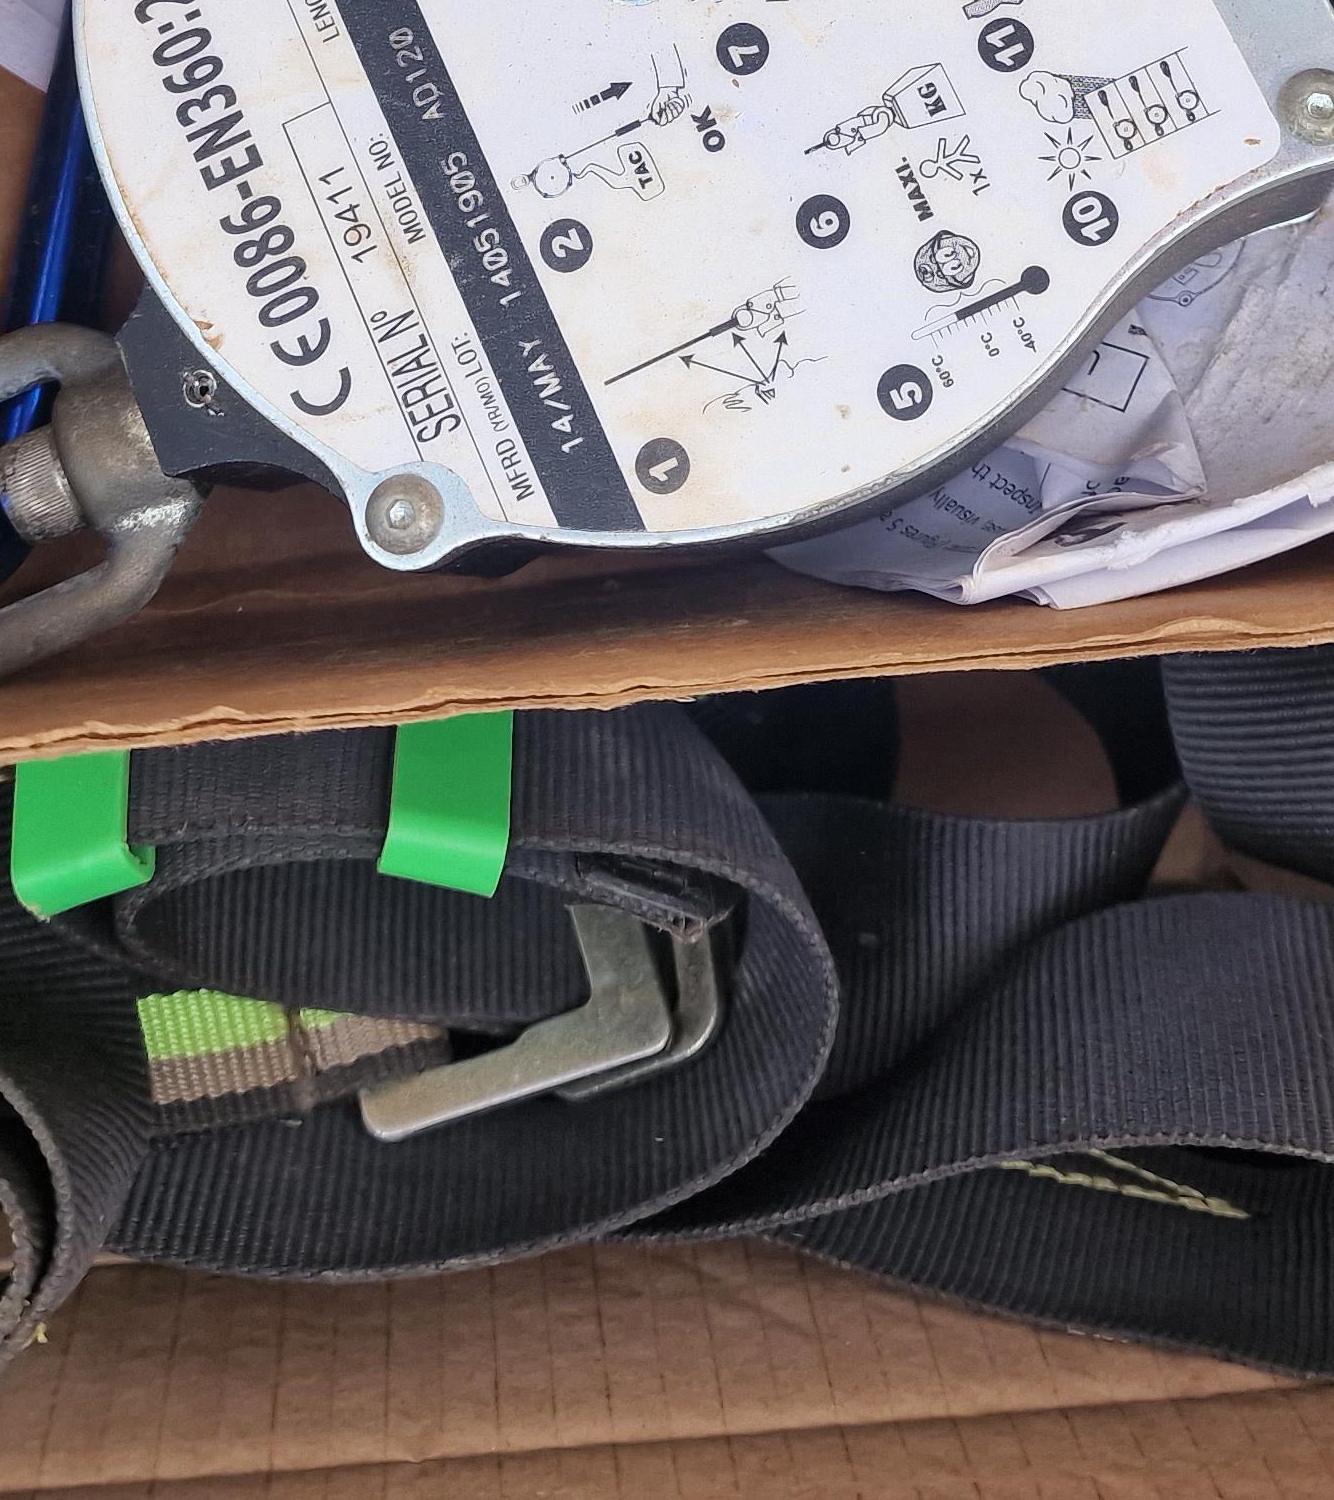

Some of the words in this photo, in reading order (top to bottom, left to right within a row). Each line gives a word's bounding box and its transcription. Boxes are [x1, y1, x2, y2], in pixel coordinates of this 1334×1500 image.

[984, 24, 1026, 67] 11
[389, 27, 446, 120] AD120
[915, 80, 948, 118] KG
[369, 133, 395, 171] NO:
[690, 106, 726, 153] OK
[629, 150, 651, 189] TAC
[894, 156, 934, 222] MAXI.
[319, 167, 378, 264] 19411
[384, 171, 426, 244] MODEL
[440, 151, 522, 308] 14051905
[1071, 197, 1110, 242] 10
[451, 332, 484, 378] LOT:
[981, 332, 1000, 357] 0°C
[387, 333, 461, 443] SERIAL
[518, 339, 584, 453] 14/MAY
[932, 355, 954, 387] 60°C
[475, 376, 510, 432] (YR/MO)
[495, 438, 535, 501] MFRD
